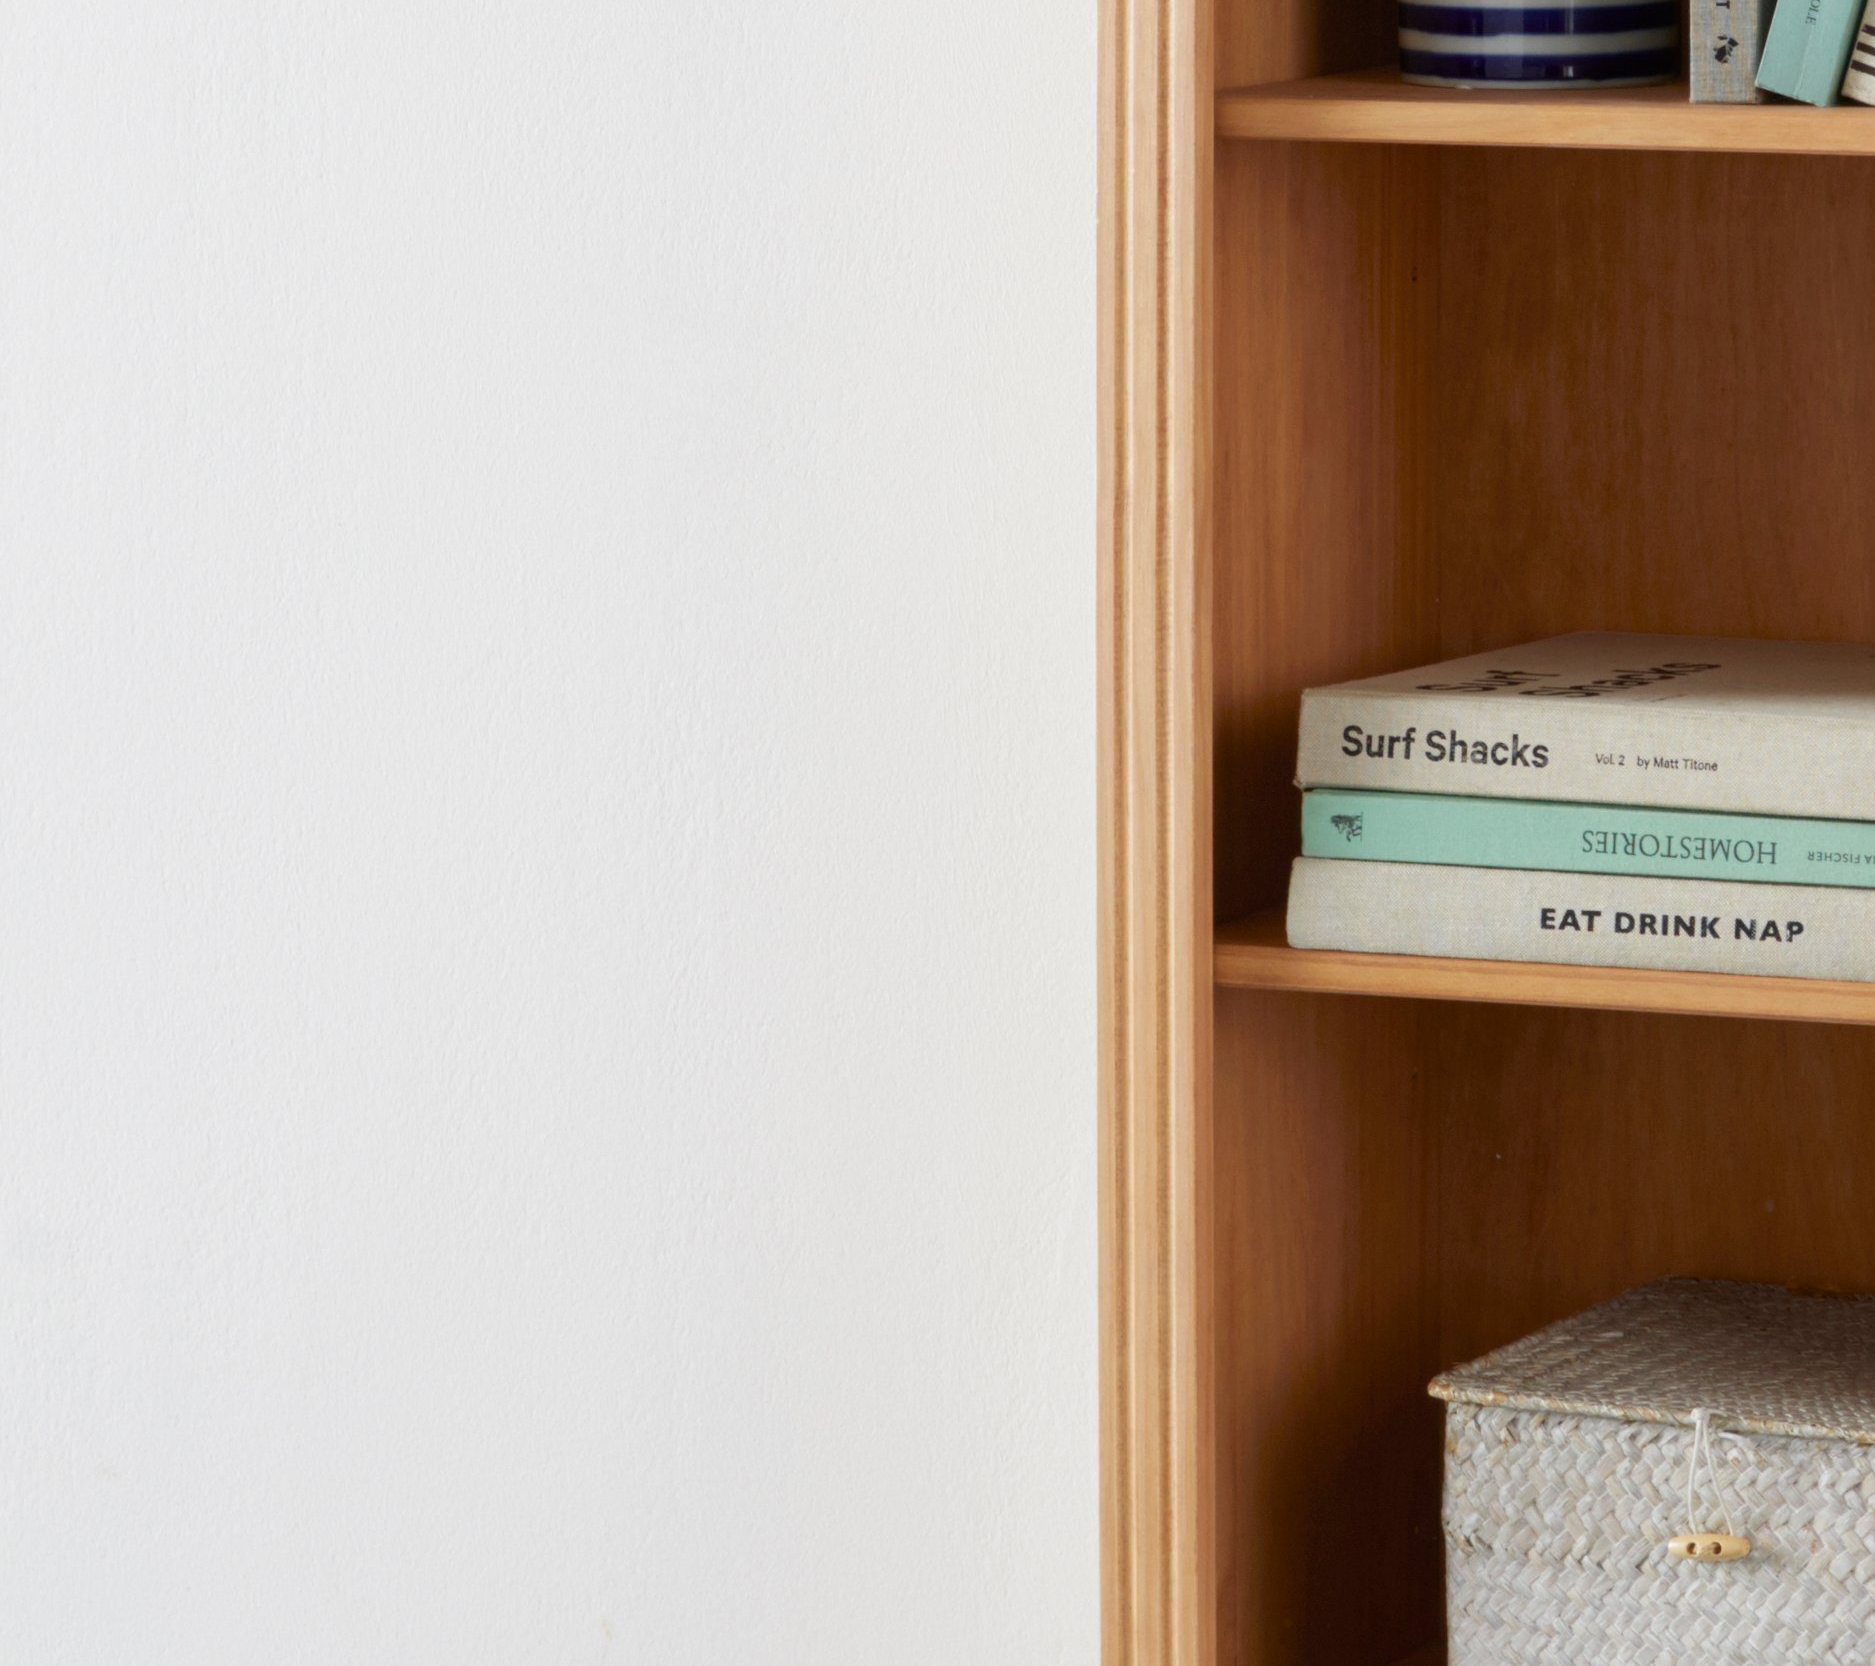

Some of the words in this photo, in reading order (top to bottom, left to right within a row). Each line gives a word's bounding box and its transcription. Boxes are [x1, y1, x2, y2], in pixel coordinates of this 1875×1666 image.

[1341, 725, 1416, 759] Surf
[1425, 729, 1549, 768] Shacks
[1618, 755, 1626, 766] 2
[1637, 755, 1650, 770] by
[1653, 757, 1679, 770] Matt
[1682, 758, 1718, 772] Titone
[1582, 830, 1777, 865] HOMESTORIES
[1807, 850, 1861, 864] FISCHER
[1540, 908, 1601, 933] EAT
[1614, 912, 1721, 940] DRINK
[1734, 918, 1804, 943] NAP
